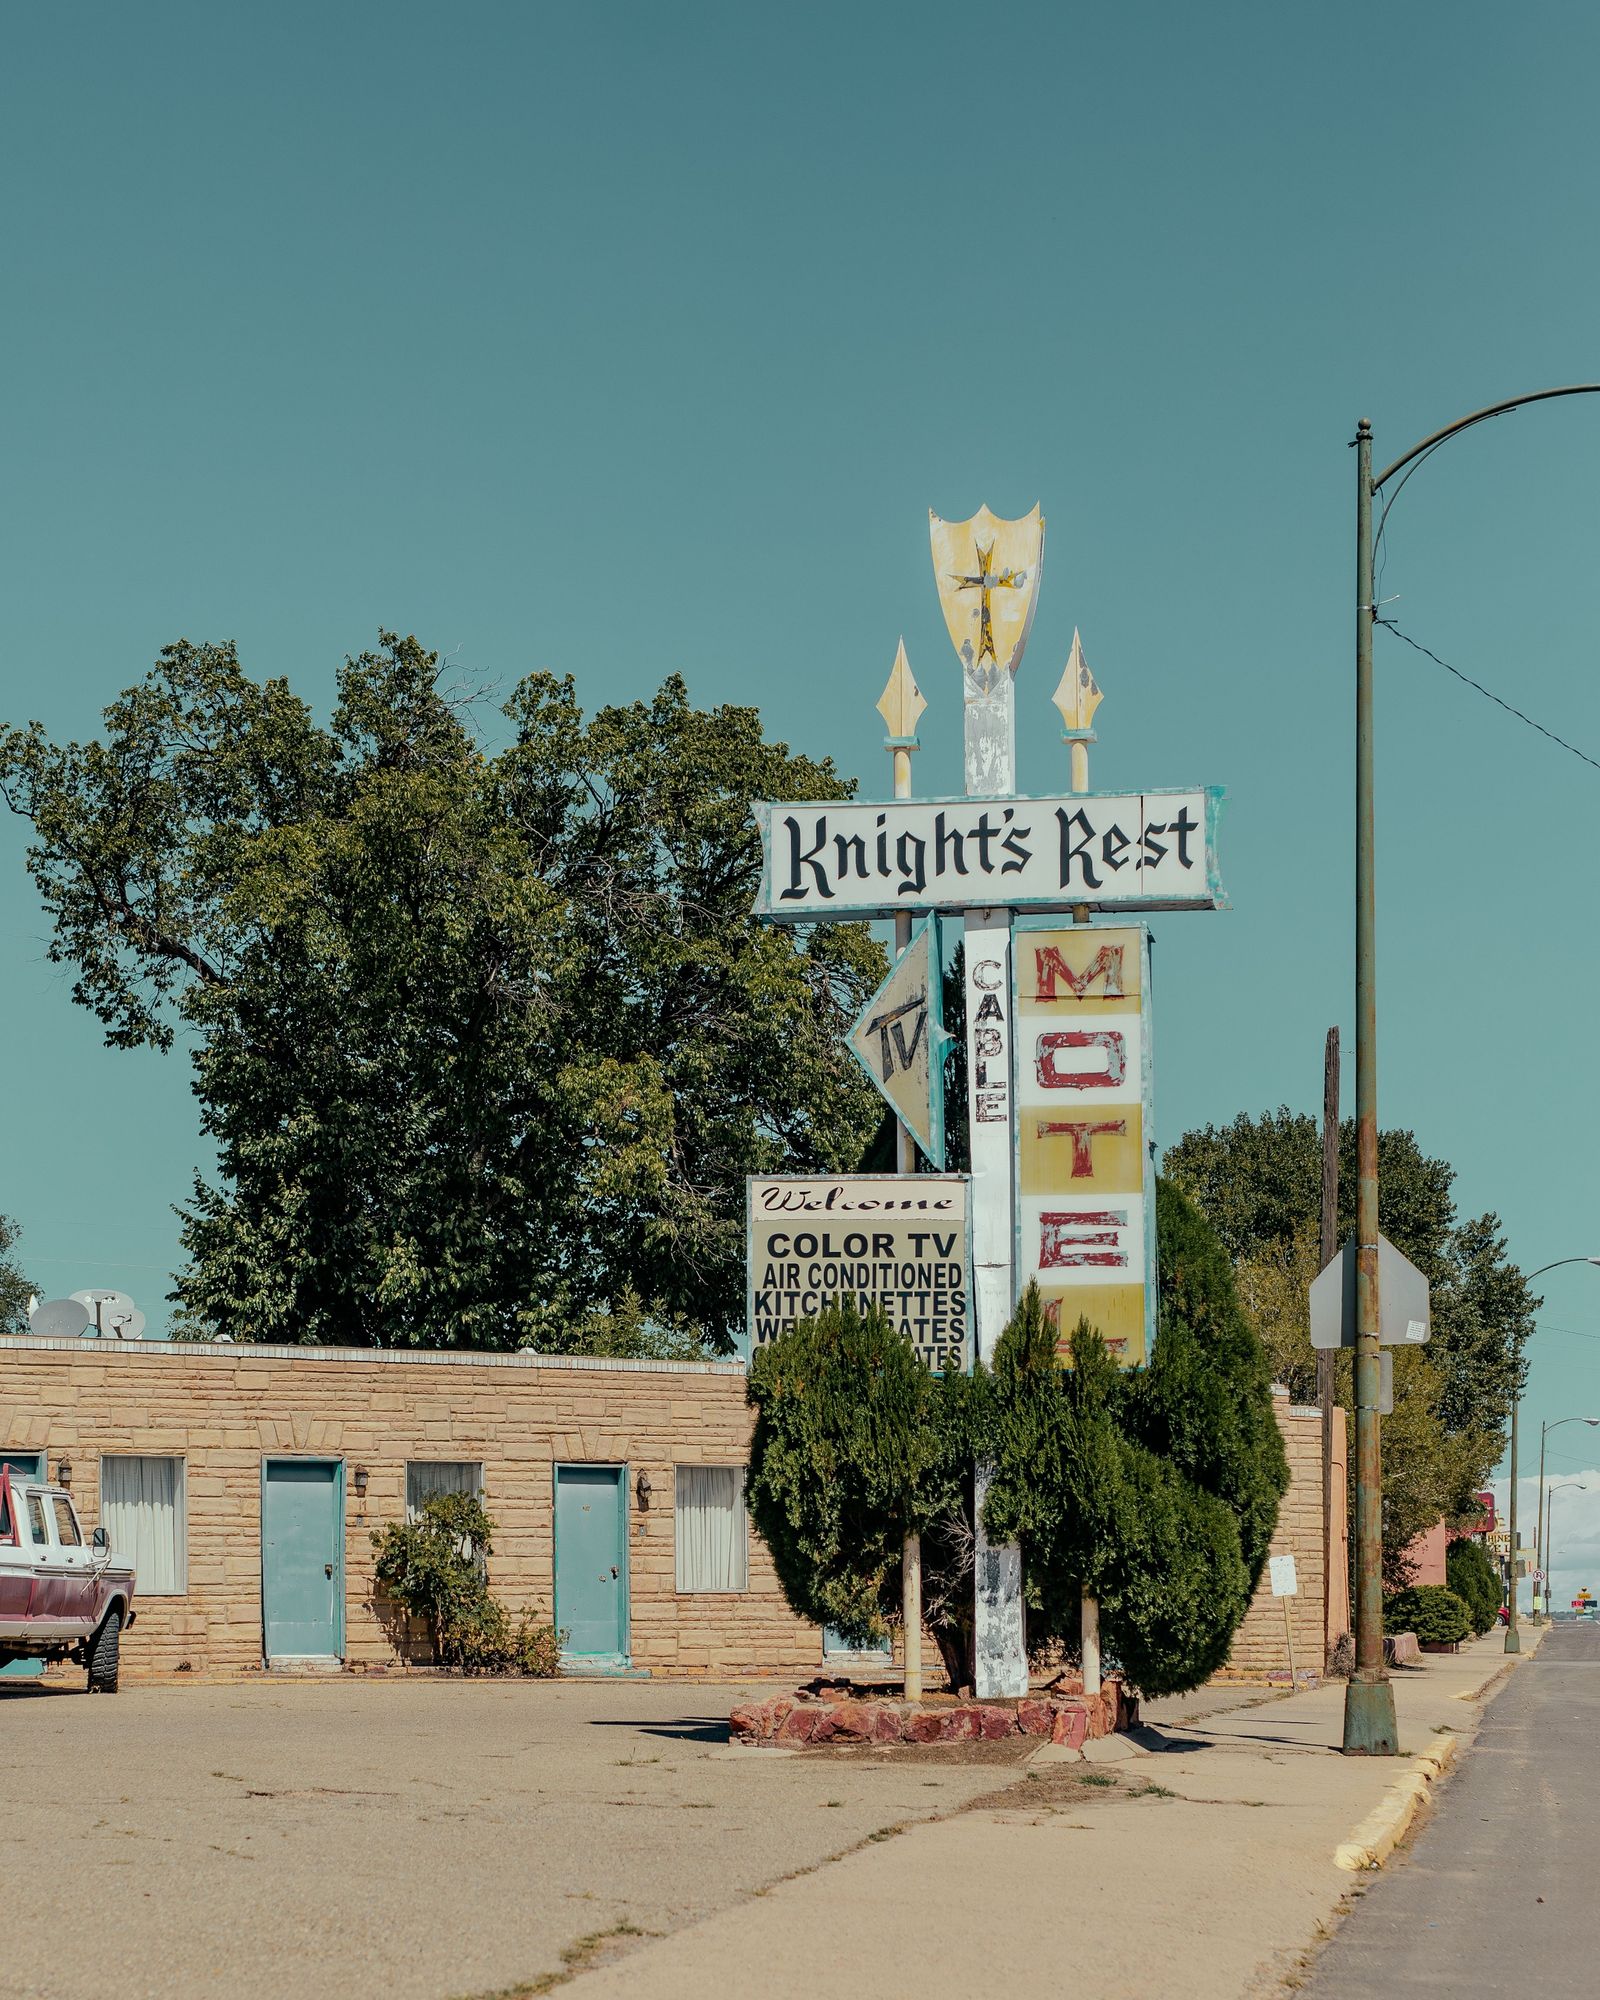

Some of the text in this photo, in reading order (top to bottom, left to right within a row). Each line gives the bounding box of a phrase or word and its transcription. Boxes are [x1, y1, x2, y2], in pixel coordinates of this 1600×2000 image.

[780, 804, 1199, 901] Knight's Rest
[865, 998, 928, 1084] TV
[972, 959, 1008, 1122] CABLE
[761, 1187, 954, 1212] Welcome
[767, 1233, 958, 1259] COLOR TV
[763, 1262, 962, 1290] AIR CONDITIONED
[888, 1318, 965, 1344] ATES
